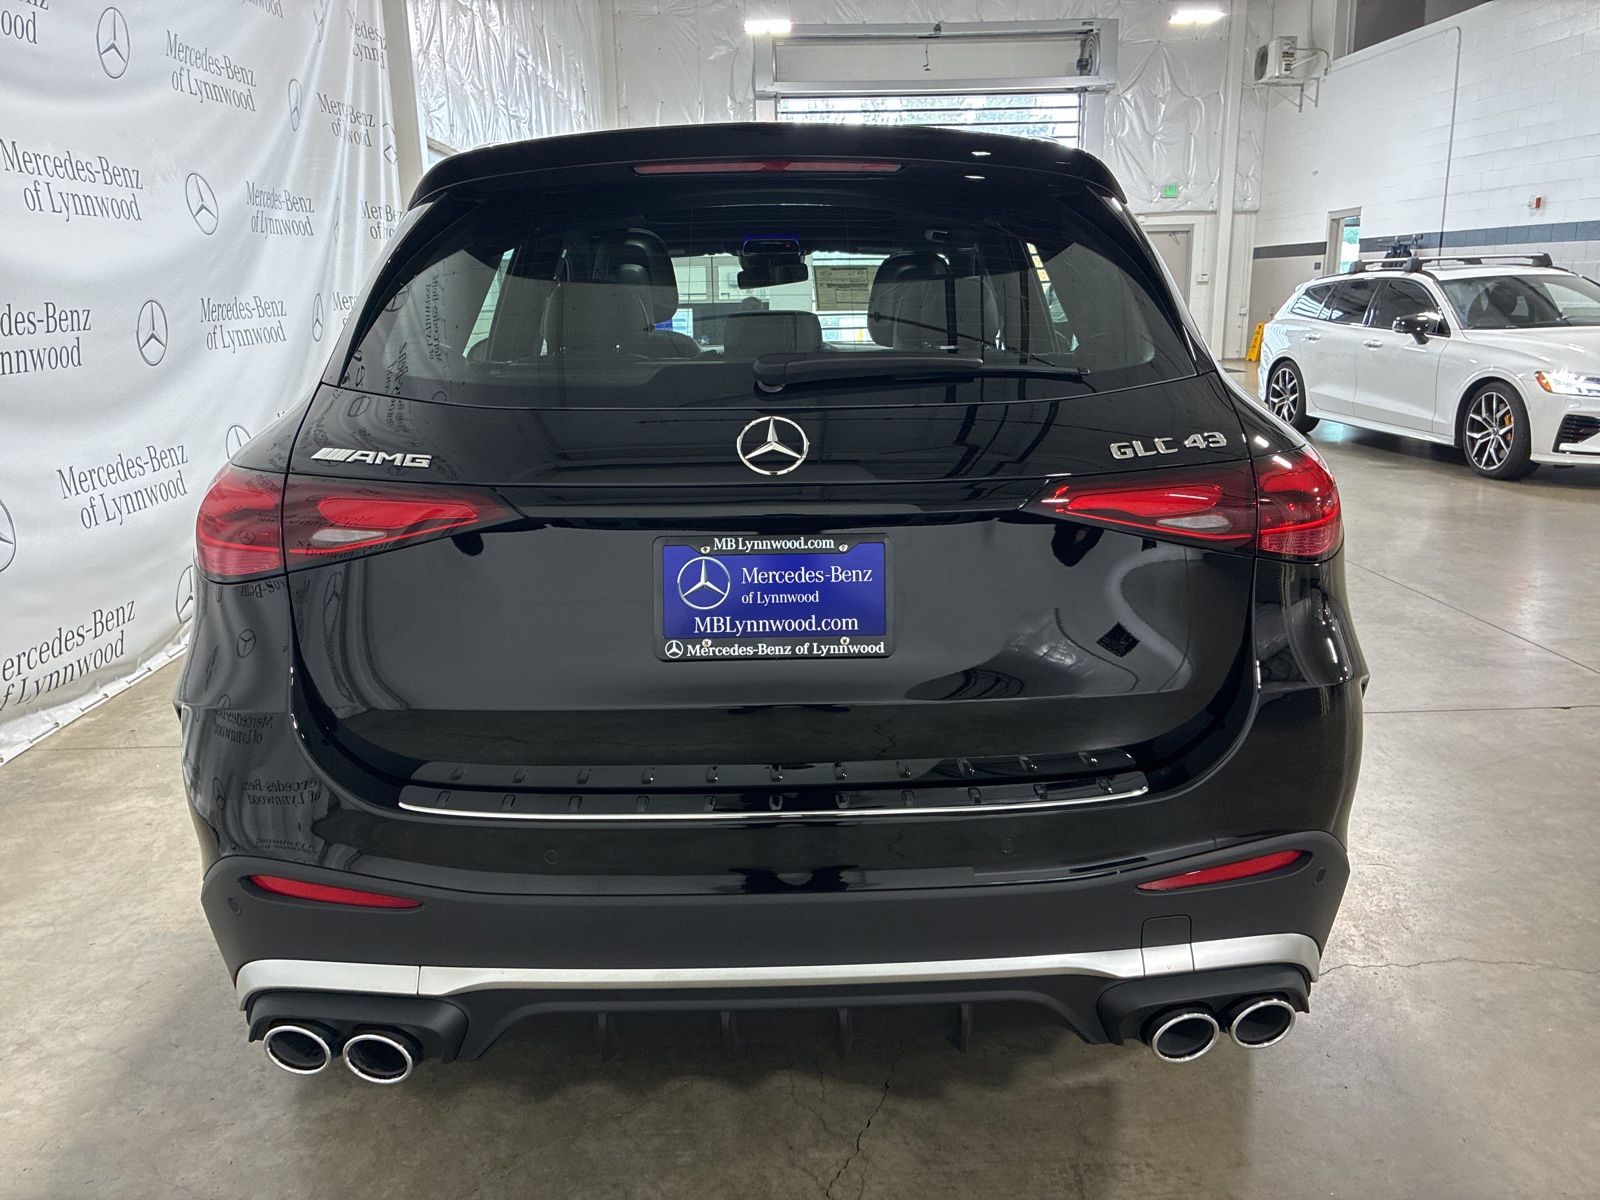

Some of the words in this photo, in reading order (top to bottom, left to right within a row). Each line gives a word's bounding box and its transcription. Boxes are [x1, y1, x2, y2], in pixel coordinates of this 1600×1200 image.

[166, 29, 257, 87] Mercedes-Benz
[172, 66, 185, 92] of
[186, 68, 257, 112] Lynnwood
[0, 138, 144, 190] Mercedes-Benz
[24, 180, 45, 212] of
[44, 181, 143, 222] Lynnwood
[246, 181, 315, 213] Mercedes-Benz
[251, 209, 260, 233] of
[260, 210, 314, 239] Lynnwood
[0, 302, 92, 337] des-Benz
[200, 295, 288, 323] Mercedes-Benz
[206, 325, 218, 351] of
[219, 320, 287, 354] Lynnwood
[0, 336, 82, 376] nnwood
[345, 450, 433, 468] AMG
[1109, 437, 1179, 460] GLC
[1183, 431, 1228, 450] 43
[56, 444, 189, 500] Mercedes-Benz
[80, 496, 100, 529] of
[98, 469, 188, 526] Lynnwood
[741, 565, 873, 584] Mercedes-Benz
[741, 592, 755, 604] of
[756, 590, 820, 607] Lynnwood
[2, 600, 136, 682] ercedes-Benz
[694, 614, 860, 637] MBLynnwood.com
[686, 643, 792, 657] Mercedes-Benz
[795, 643, 809, 655] of
[812, 642, 885, 657] Lynnwood
[15, 629, 125, 706] Lynnwood
